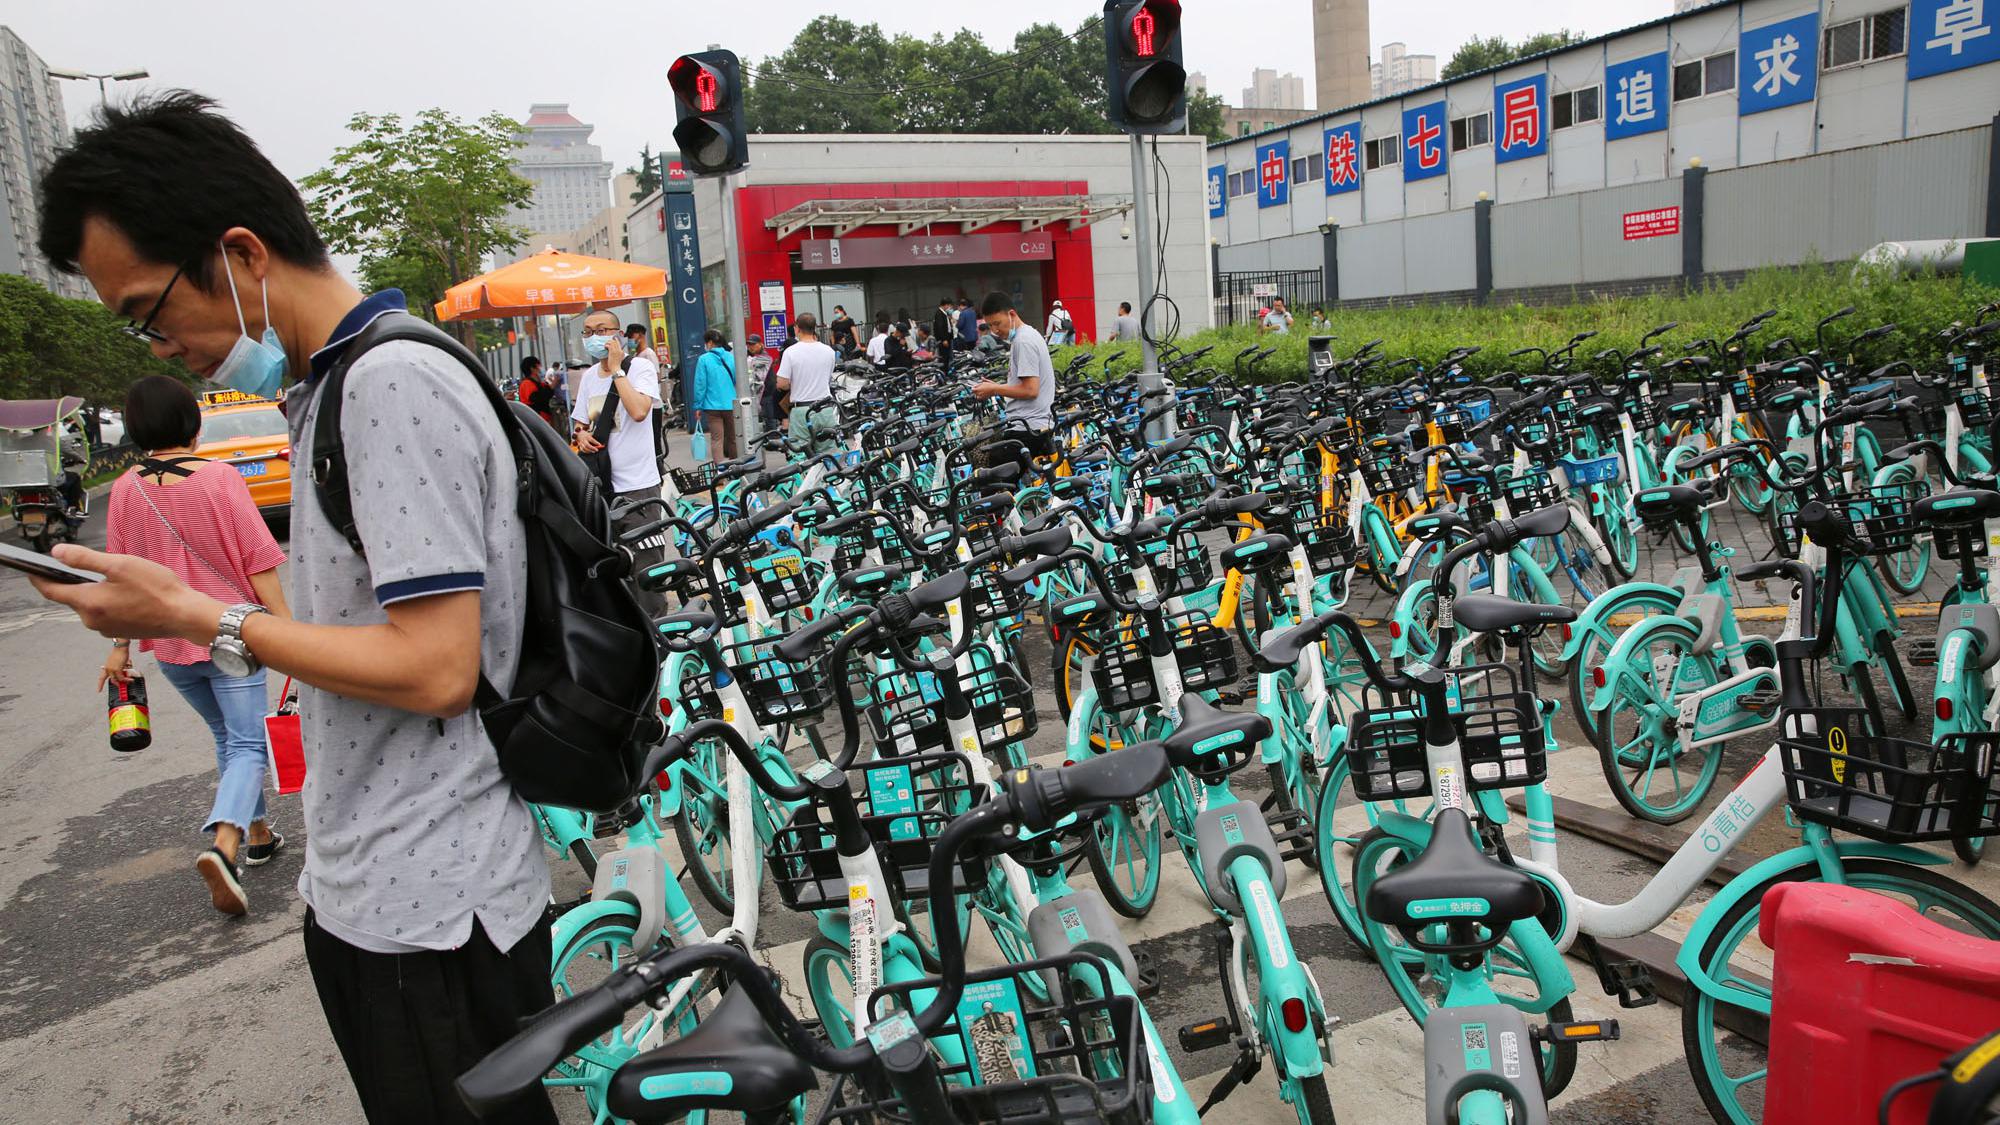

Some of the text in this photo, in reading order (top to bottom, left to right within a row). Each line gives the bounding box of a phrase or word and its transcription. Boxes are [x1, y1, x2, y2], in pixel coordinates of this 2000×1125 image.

[680, 234, 695, 276] 青龙寺
[832, 247, 839, 258] 3
[911, 244, 954, 256] 青龙寺站
[1020, 242, 1030, 254] C
[526, 283, 633, 302] 早餐 午餐 晚餐
[682, 287, 697, 304] C
[1450, 901, 1483, 912] 免押金
[994, 1039, 1011, 1068] 200
